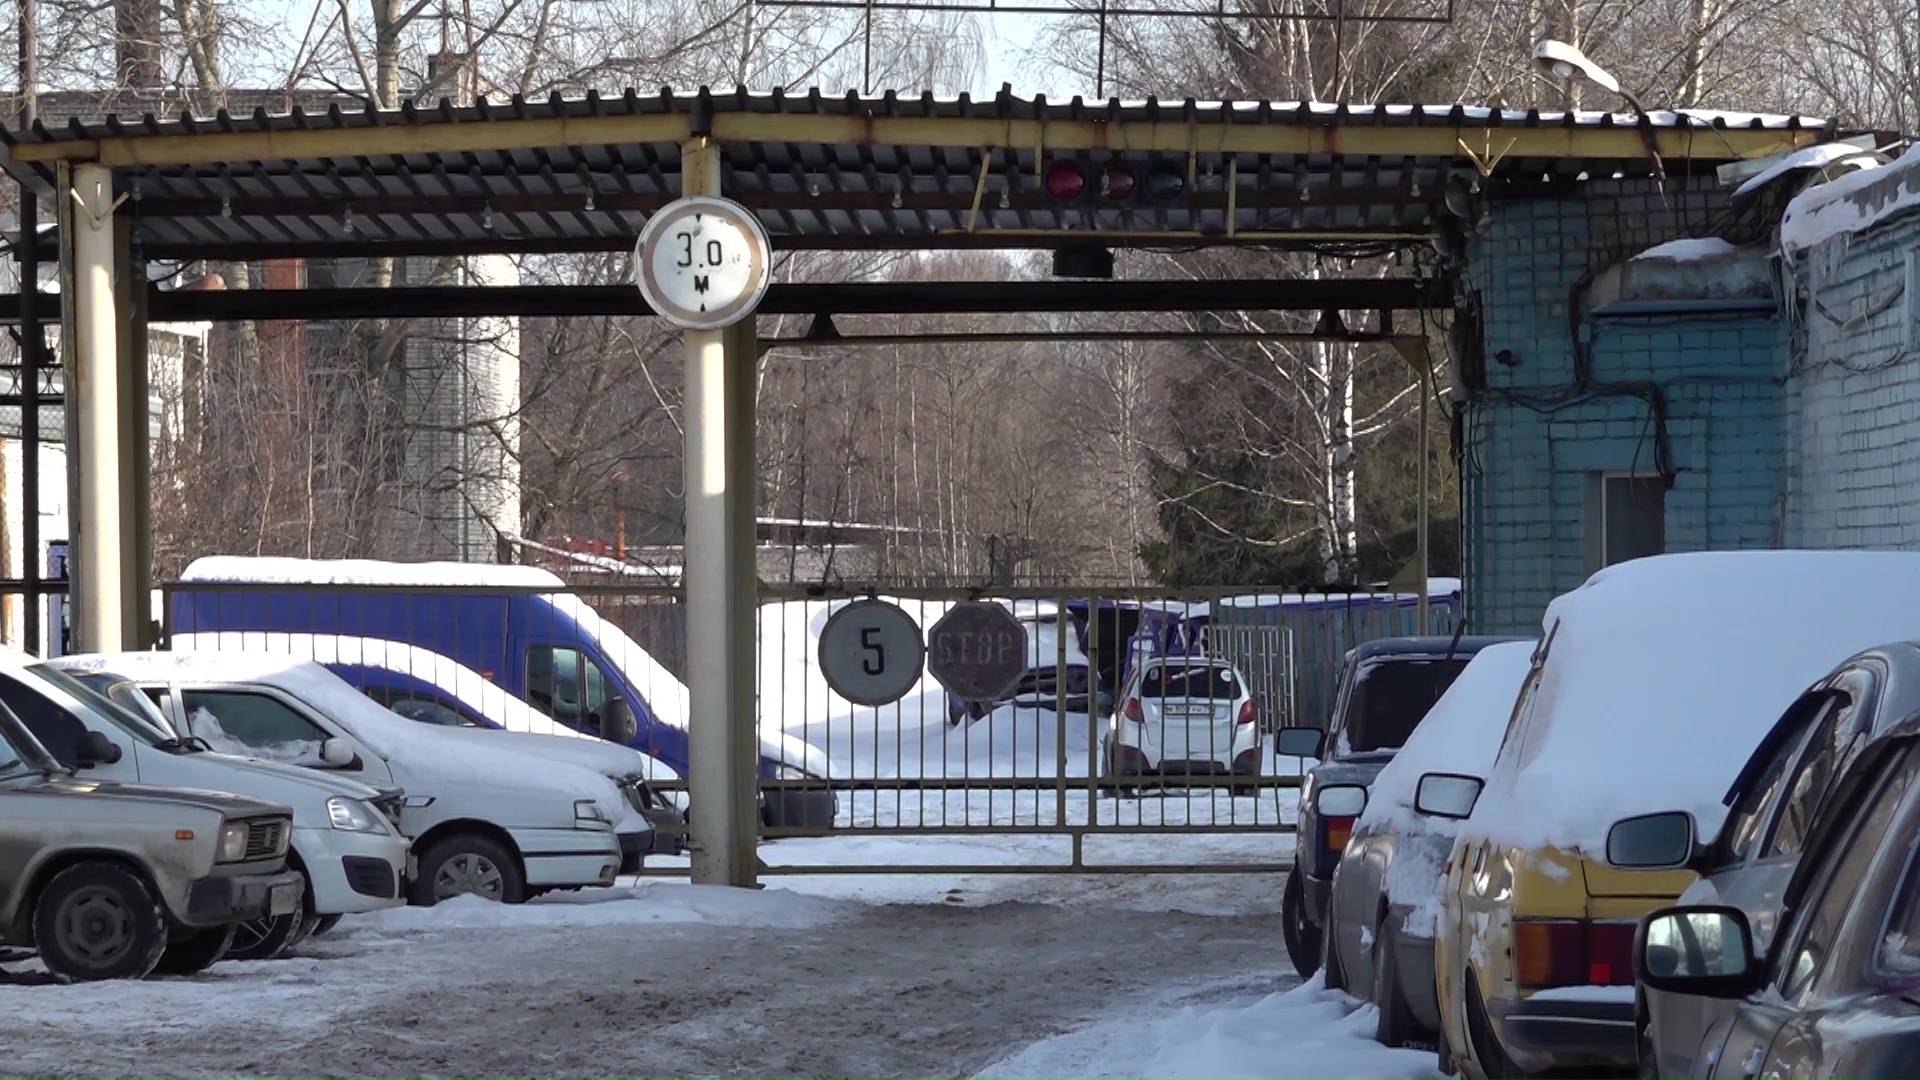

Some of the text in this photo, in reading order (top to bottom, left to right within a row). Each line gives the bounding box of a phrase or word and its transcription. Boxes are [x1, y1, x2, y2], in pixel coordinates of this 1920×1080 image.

[677, 231, 723, 268] 3.0
[861, 627, 885, 676] 5
[937, 632, 1012, 665] STOP
